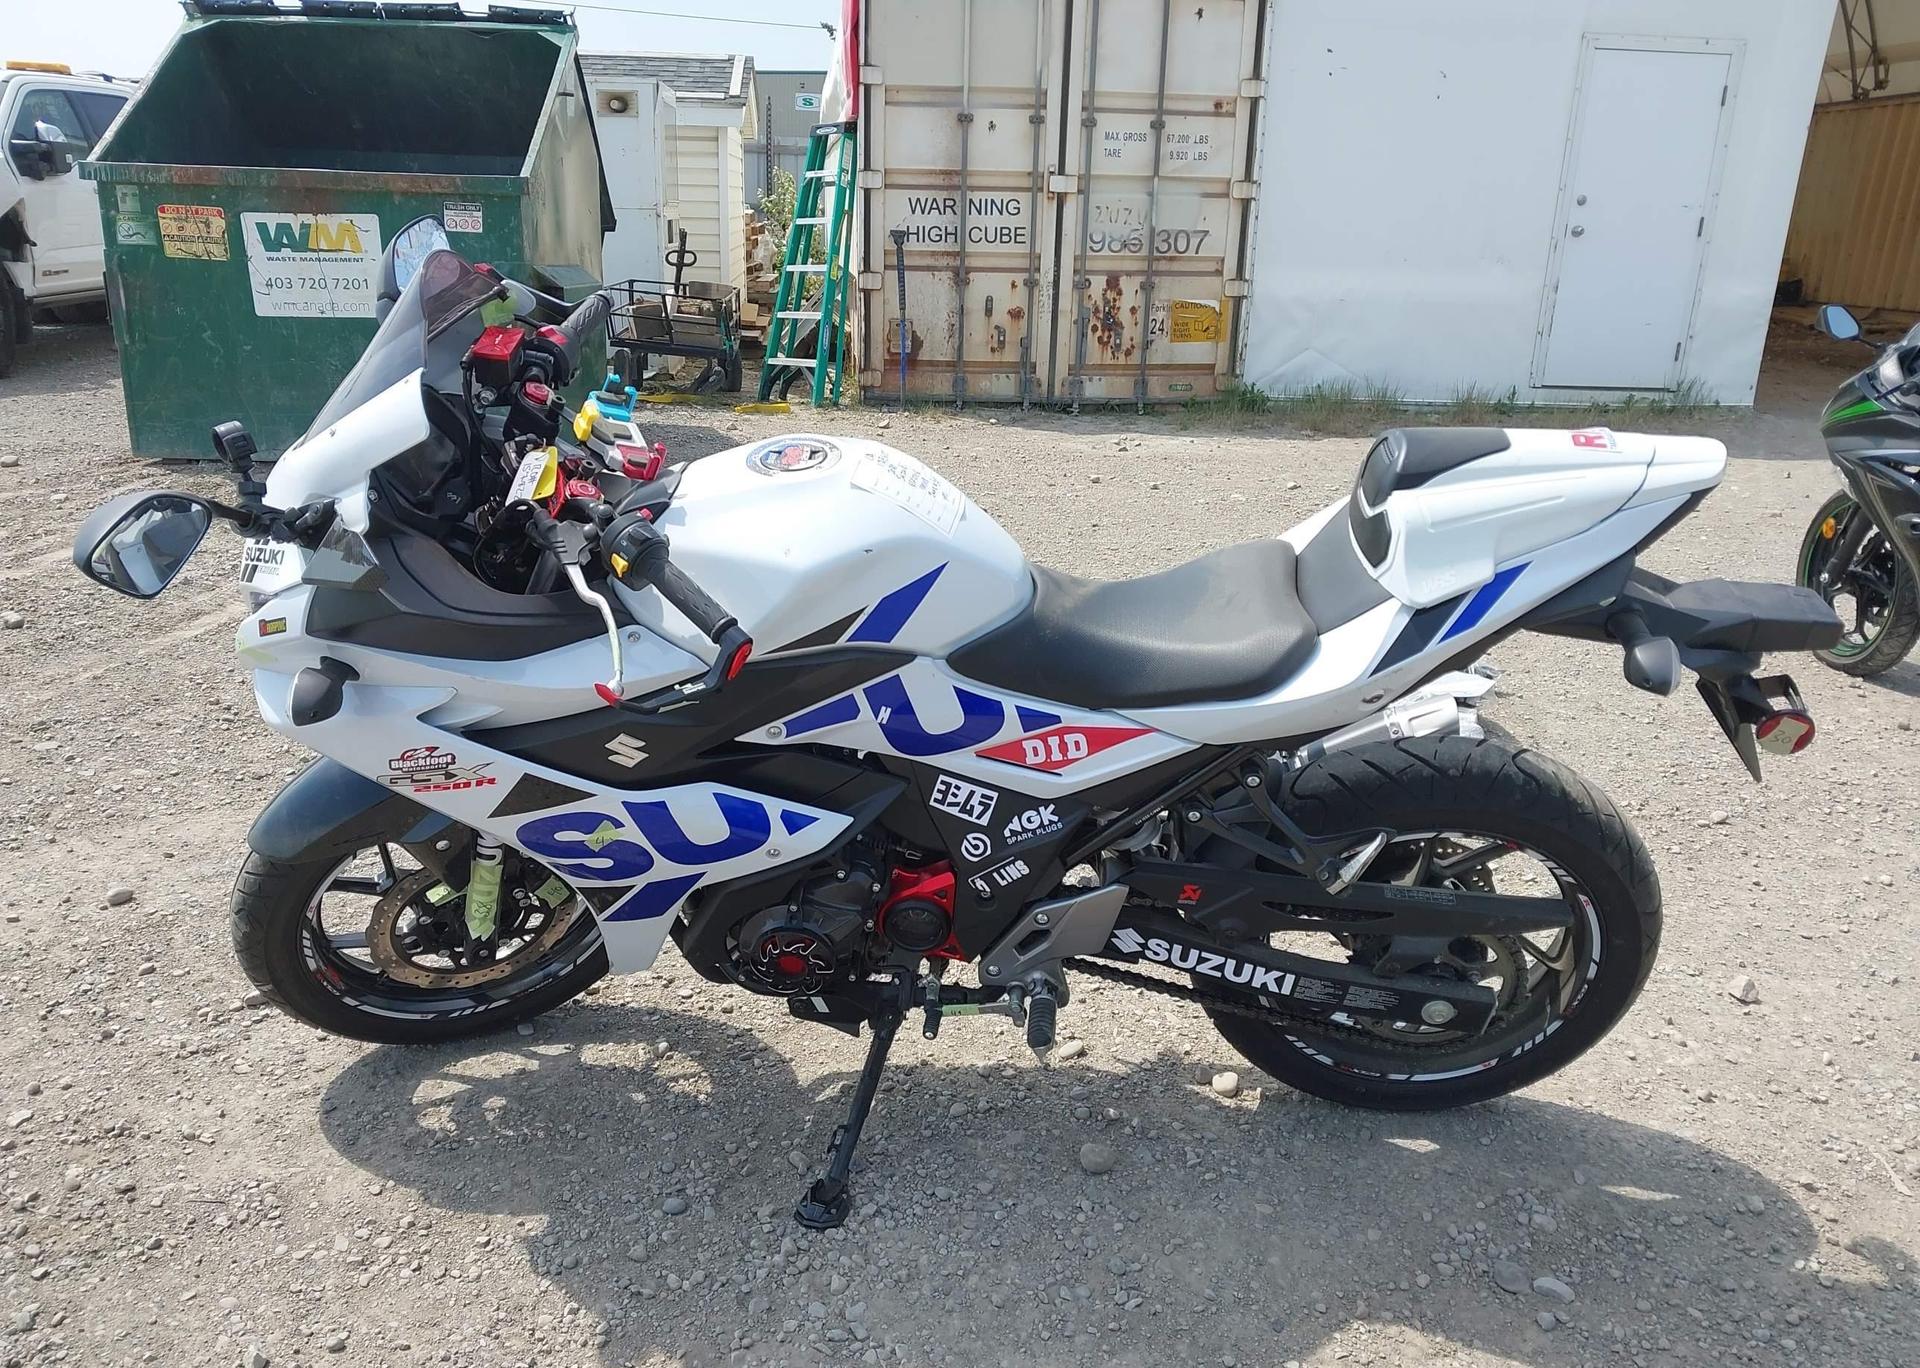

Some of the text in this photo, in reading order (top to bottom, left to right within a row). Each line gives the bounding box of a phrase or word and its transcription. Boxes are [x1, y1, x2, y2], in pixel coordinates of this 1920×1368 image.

[1123, 131, 1147, 142] GROSS
[1194, 135, 1209, 144] LBS
[1104, 148, 1122, 158] TARE
[1193, 152, 1208, 161] LBS
[198, 208, 219, 216] PARK
[255, 222, 363, 255] WM
[906, 225, 1026, 244] HIGH CUBE
[265, 277, 369, 290] 403 720 7201
[271, 301, 370, 312] wmcanada.com
[245, 547, 285, 565] SUZUKI
[391, 754, 453, 769] Blackfoot
[1003, 803, 1060, 838] NGK
[1006, 822, 1063, 845] SPARK PLUGS
[1144, 938, 1296, 996] SUZUKI
